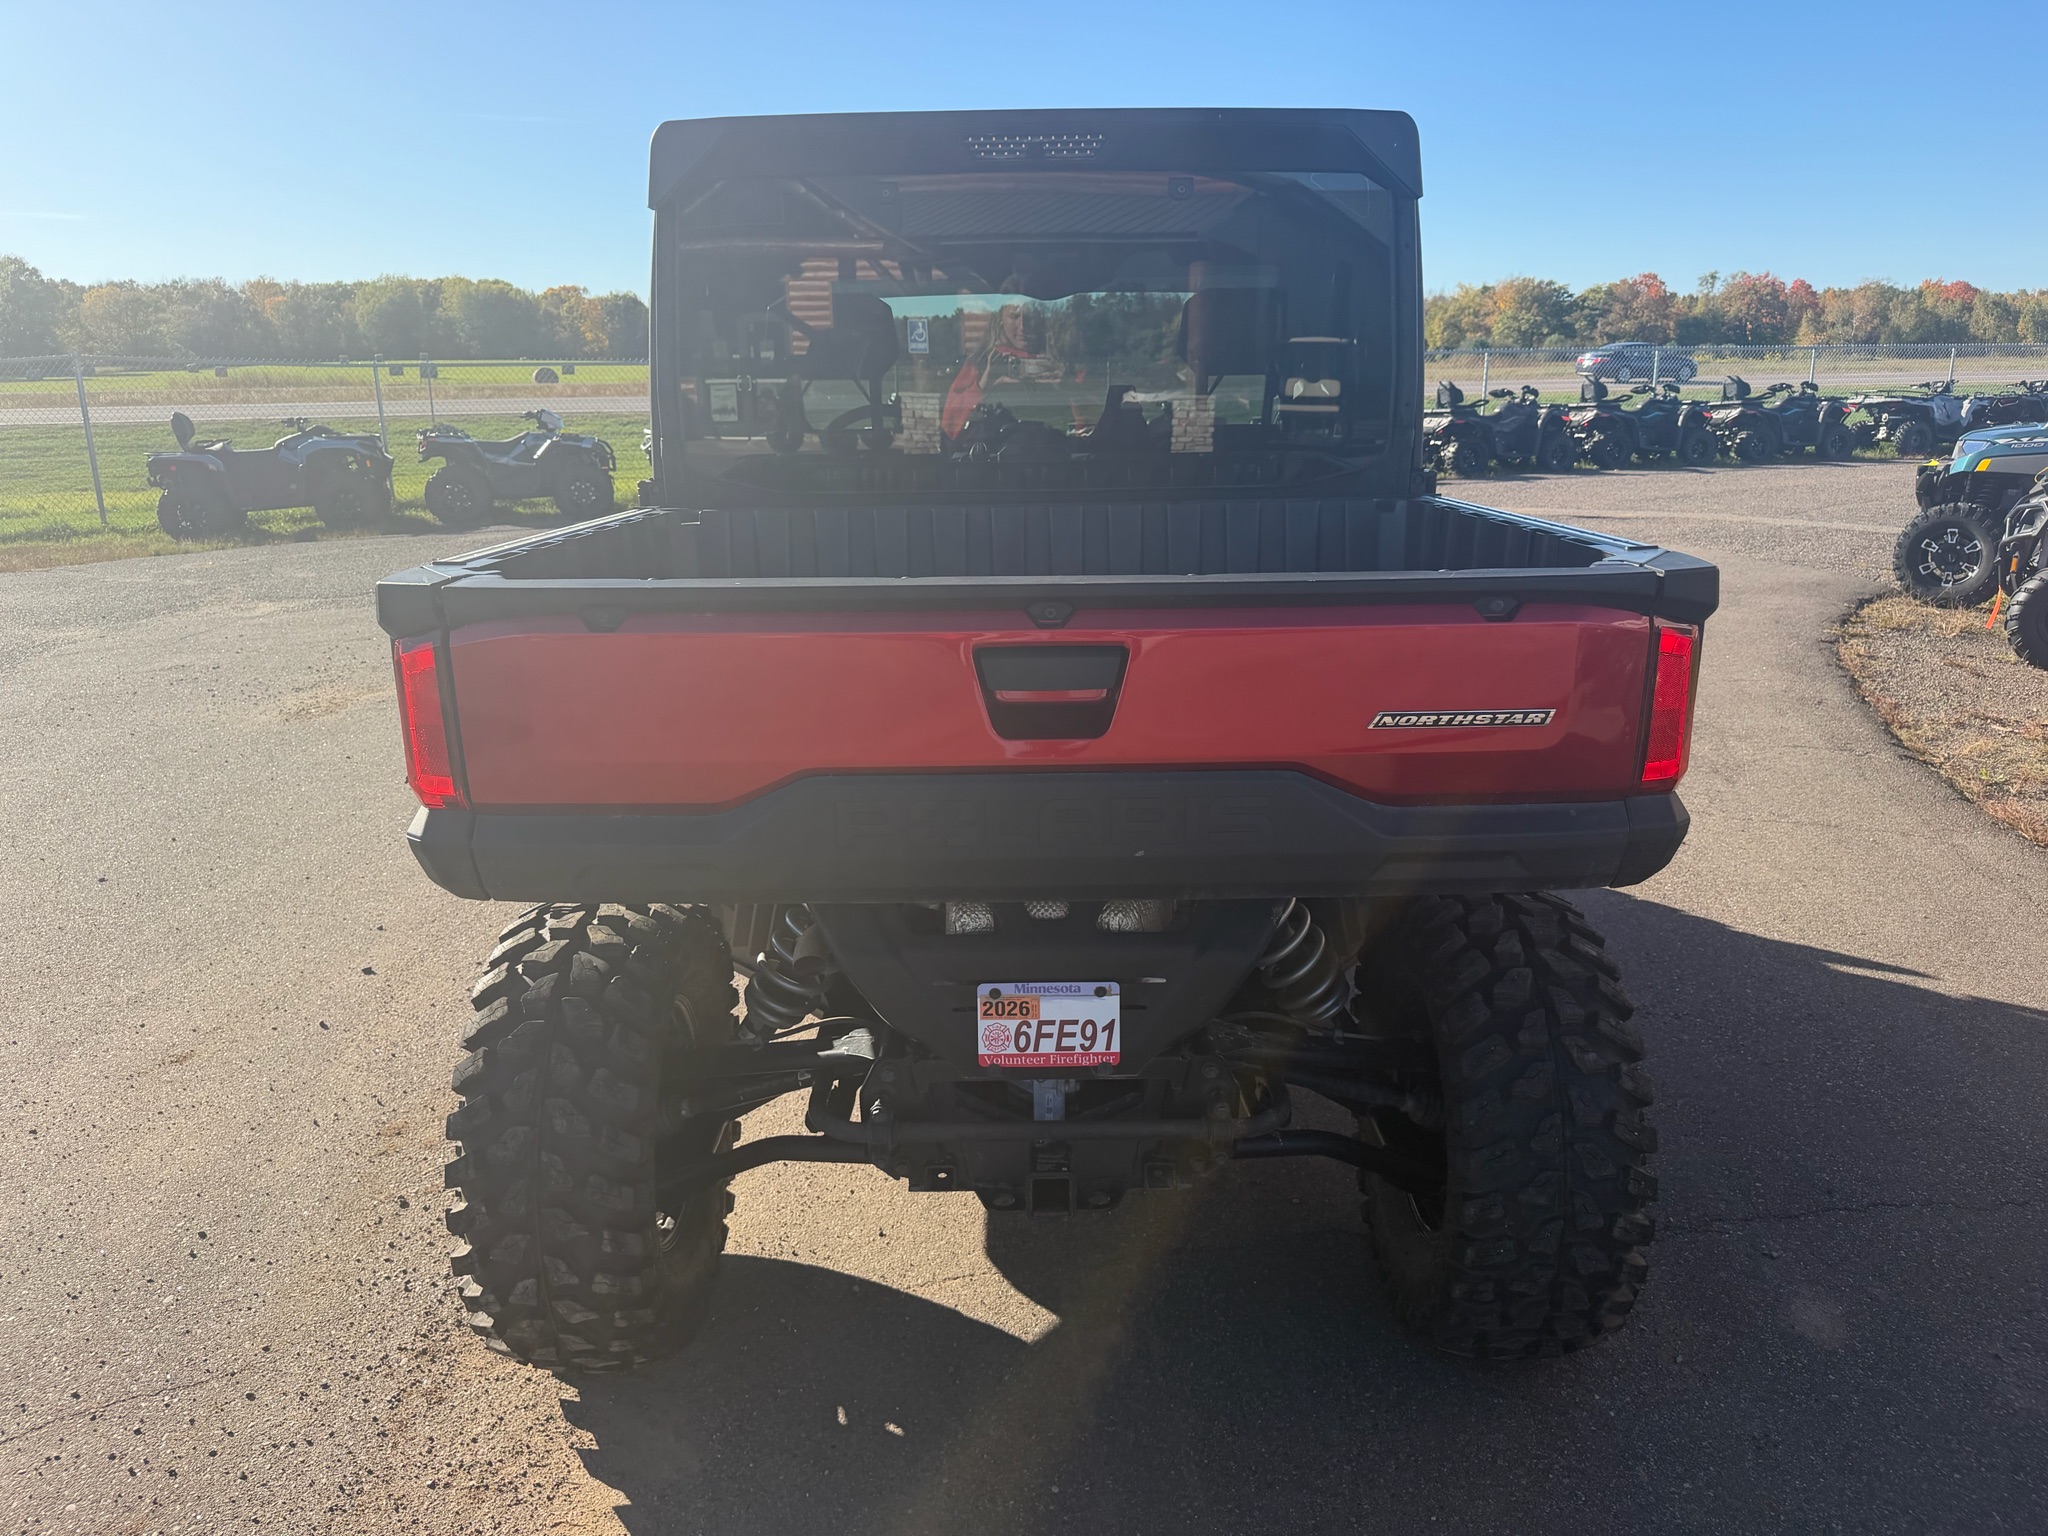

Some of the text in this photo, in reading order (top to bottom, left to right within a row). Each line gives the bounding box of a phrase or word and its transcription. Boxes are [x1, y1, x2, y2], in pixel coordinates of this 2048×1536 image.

[1378, 713, 1546, 726] NORTHSTAR
[833, 796, 1271, 847] POLARIS
[1014, 983, 1081, 994] Minnesota
[982, 1000, 1030, 1017] 2026
[1014, 1018, 1116, 1053] 6FE91
[984, 1054, 1115, 1065] Volunteer Firefighter
